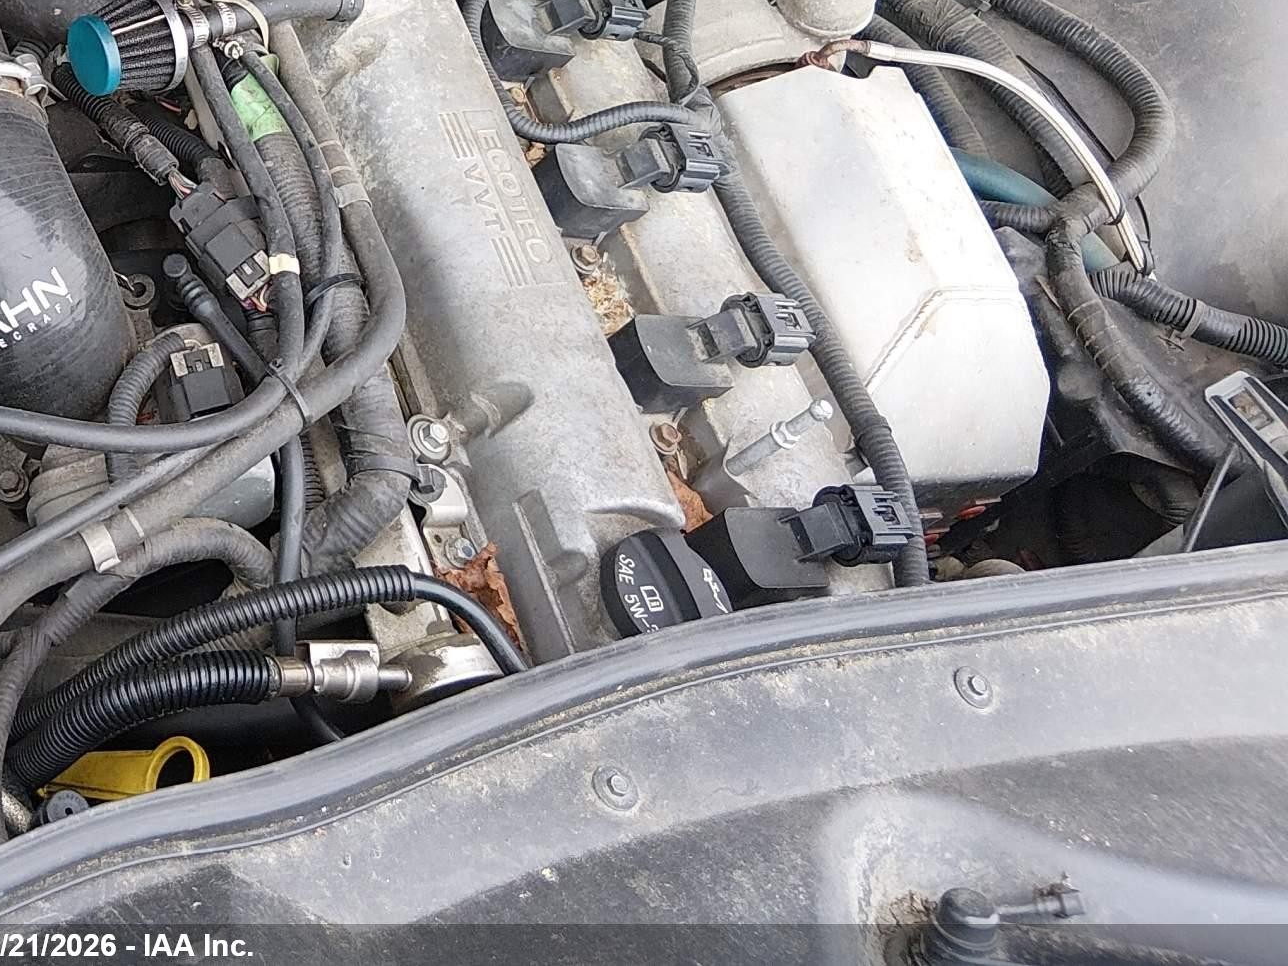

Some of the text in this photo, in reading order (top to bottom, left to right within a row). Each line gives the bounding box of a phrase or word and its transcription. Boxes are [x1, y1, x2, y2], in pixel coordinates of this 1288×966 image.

[464, 163, 507, 231] VVT
[476, 129, 553, 264] ECOTEC
[617, 553, 636, 586] SAE
